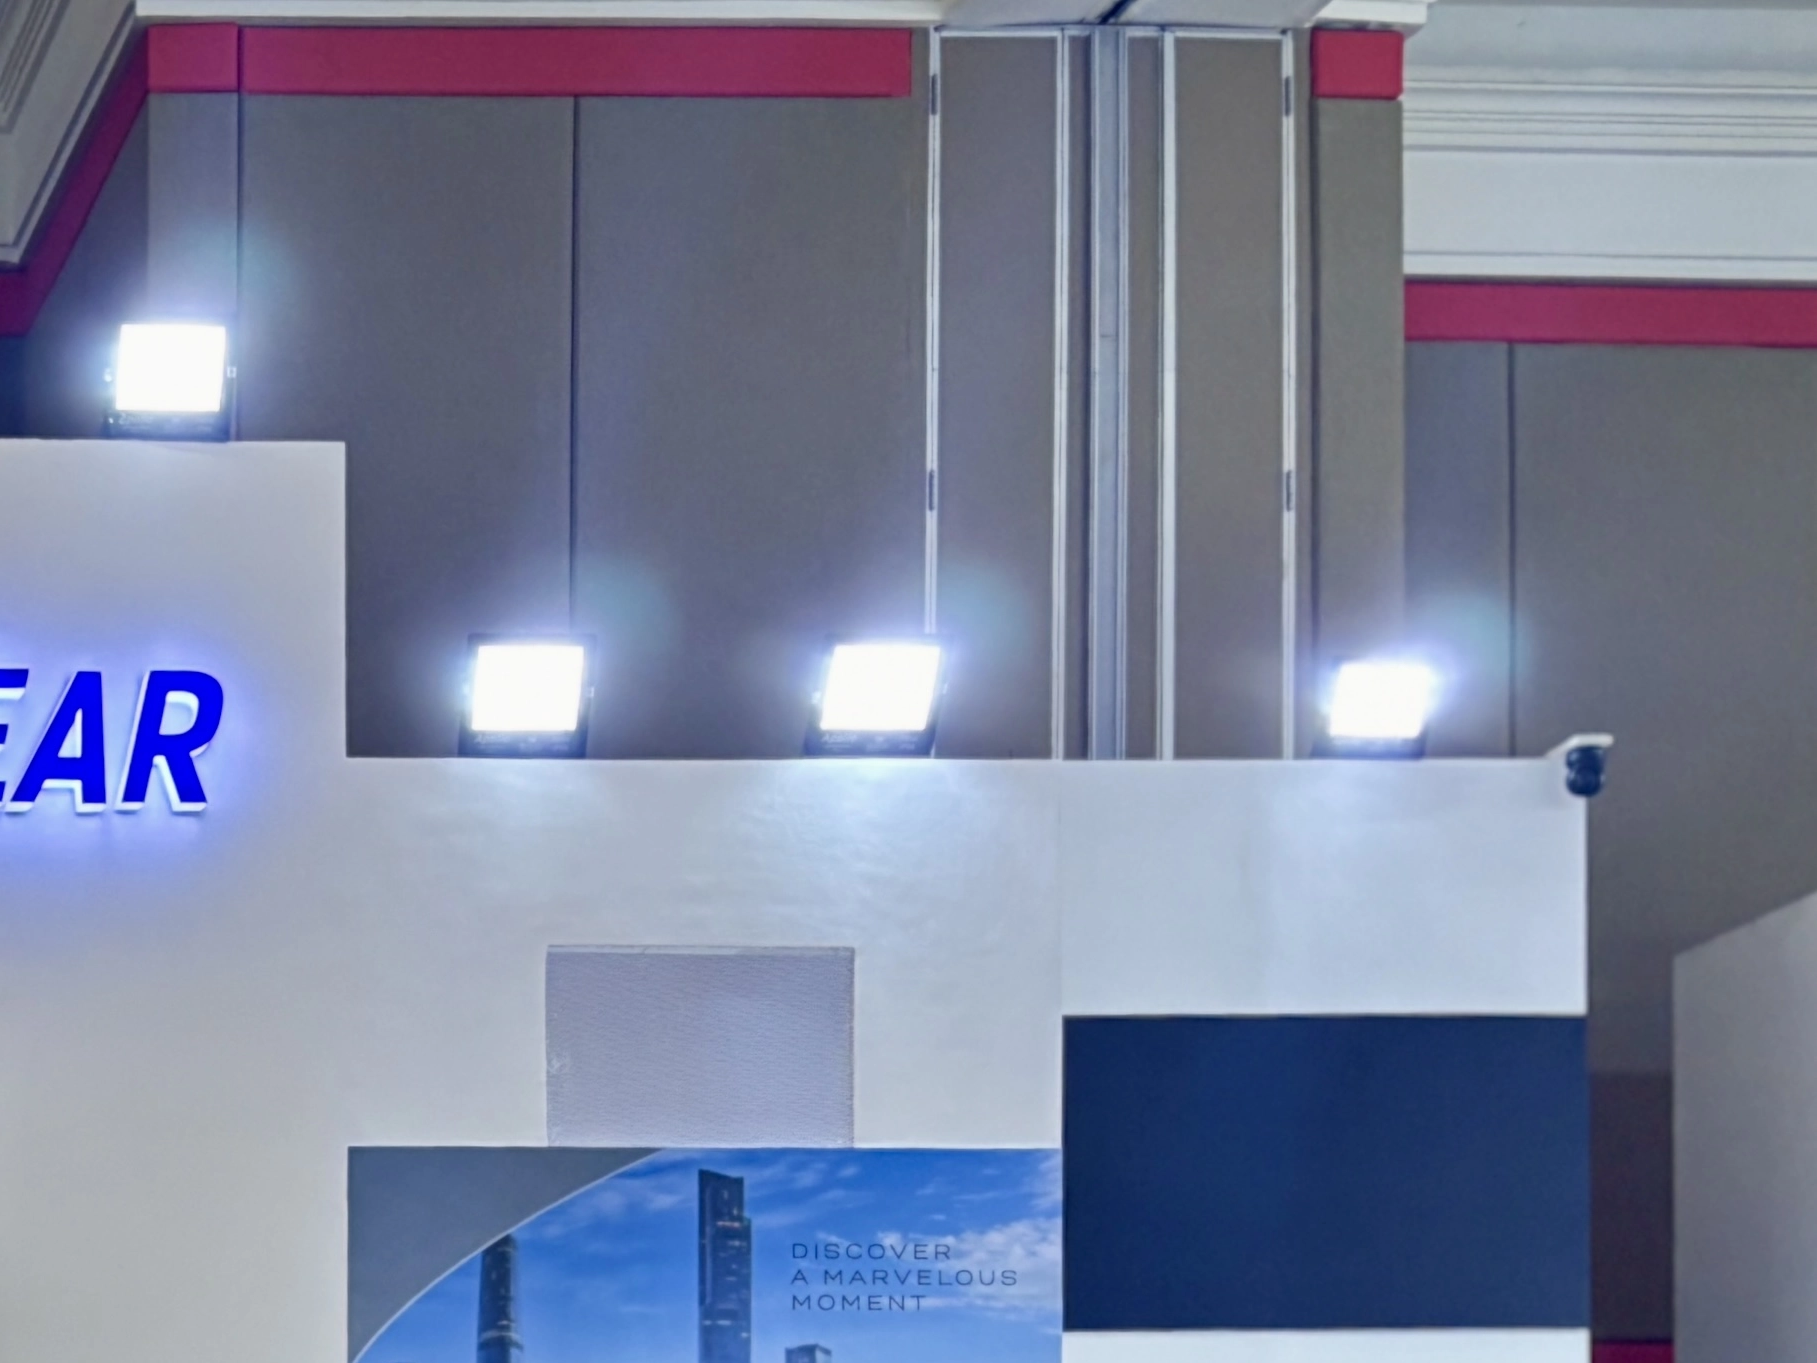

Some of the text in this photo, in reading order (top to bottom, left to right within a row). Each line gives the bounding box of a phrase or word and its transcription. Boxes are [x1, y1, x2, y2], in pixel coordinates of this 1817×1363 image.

[792, 1243, 951, 1259] DISCOVER
[791, 1269, 1019, 1287] A MARVELOUS
[792, 1295, 927, 1311] MOMENT
